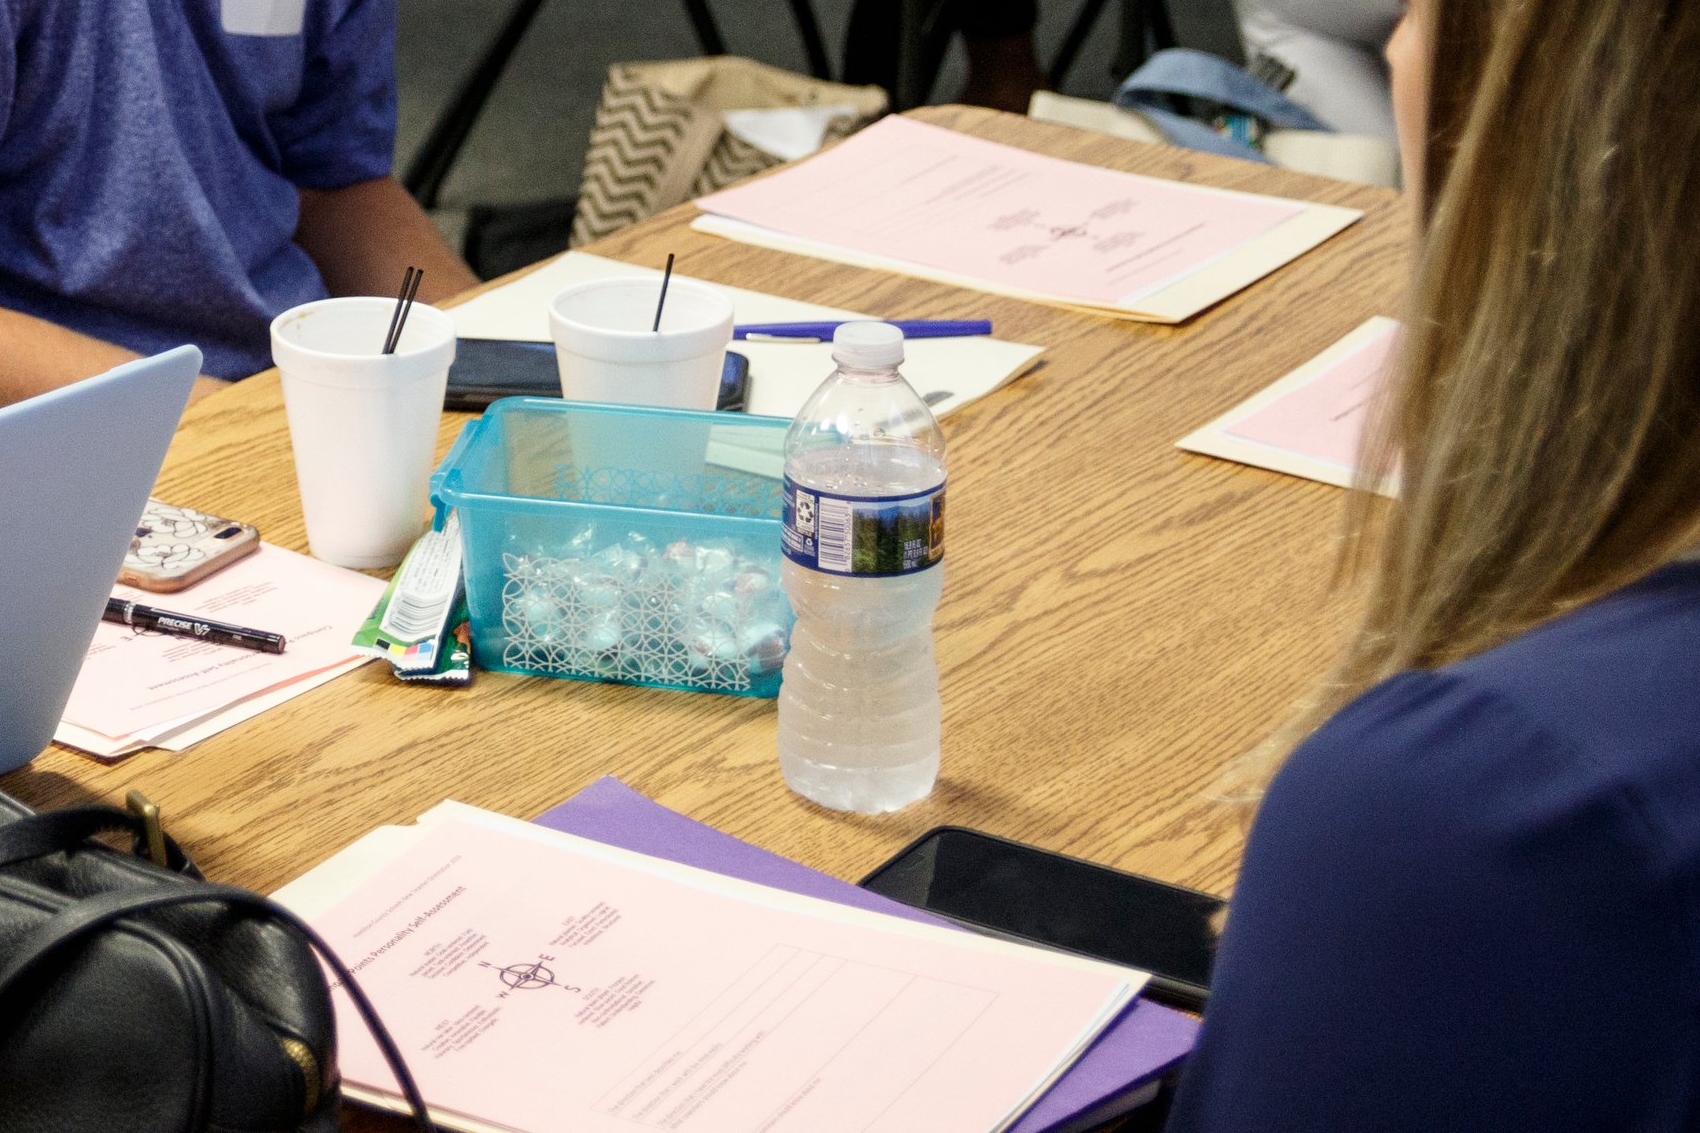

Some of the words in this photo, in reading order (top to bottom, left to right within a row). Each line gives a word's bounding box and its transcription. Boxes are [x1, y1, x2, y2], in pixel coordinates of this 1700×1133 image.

[157, 617, 193, 630] PRECISE
[194, 623, 211, 636] V7
[349, 956, 376, 974] Points
[370, 927, 415, 957] Personality
[408, 885, 467, 928] Self-Assessment
[538, 953, 556, 962] E
[477, 960, 492, 969] N
[564, 984, 582, 994] S
[495, 991, 510, 999] W
